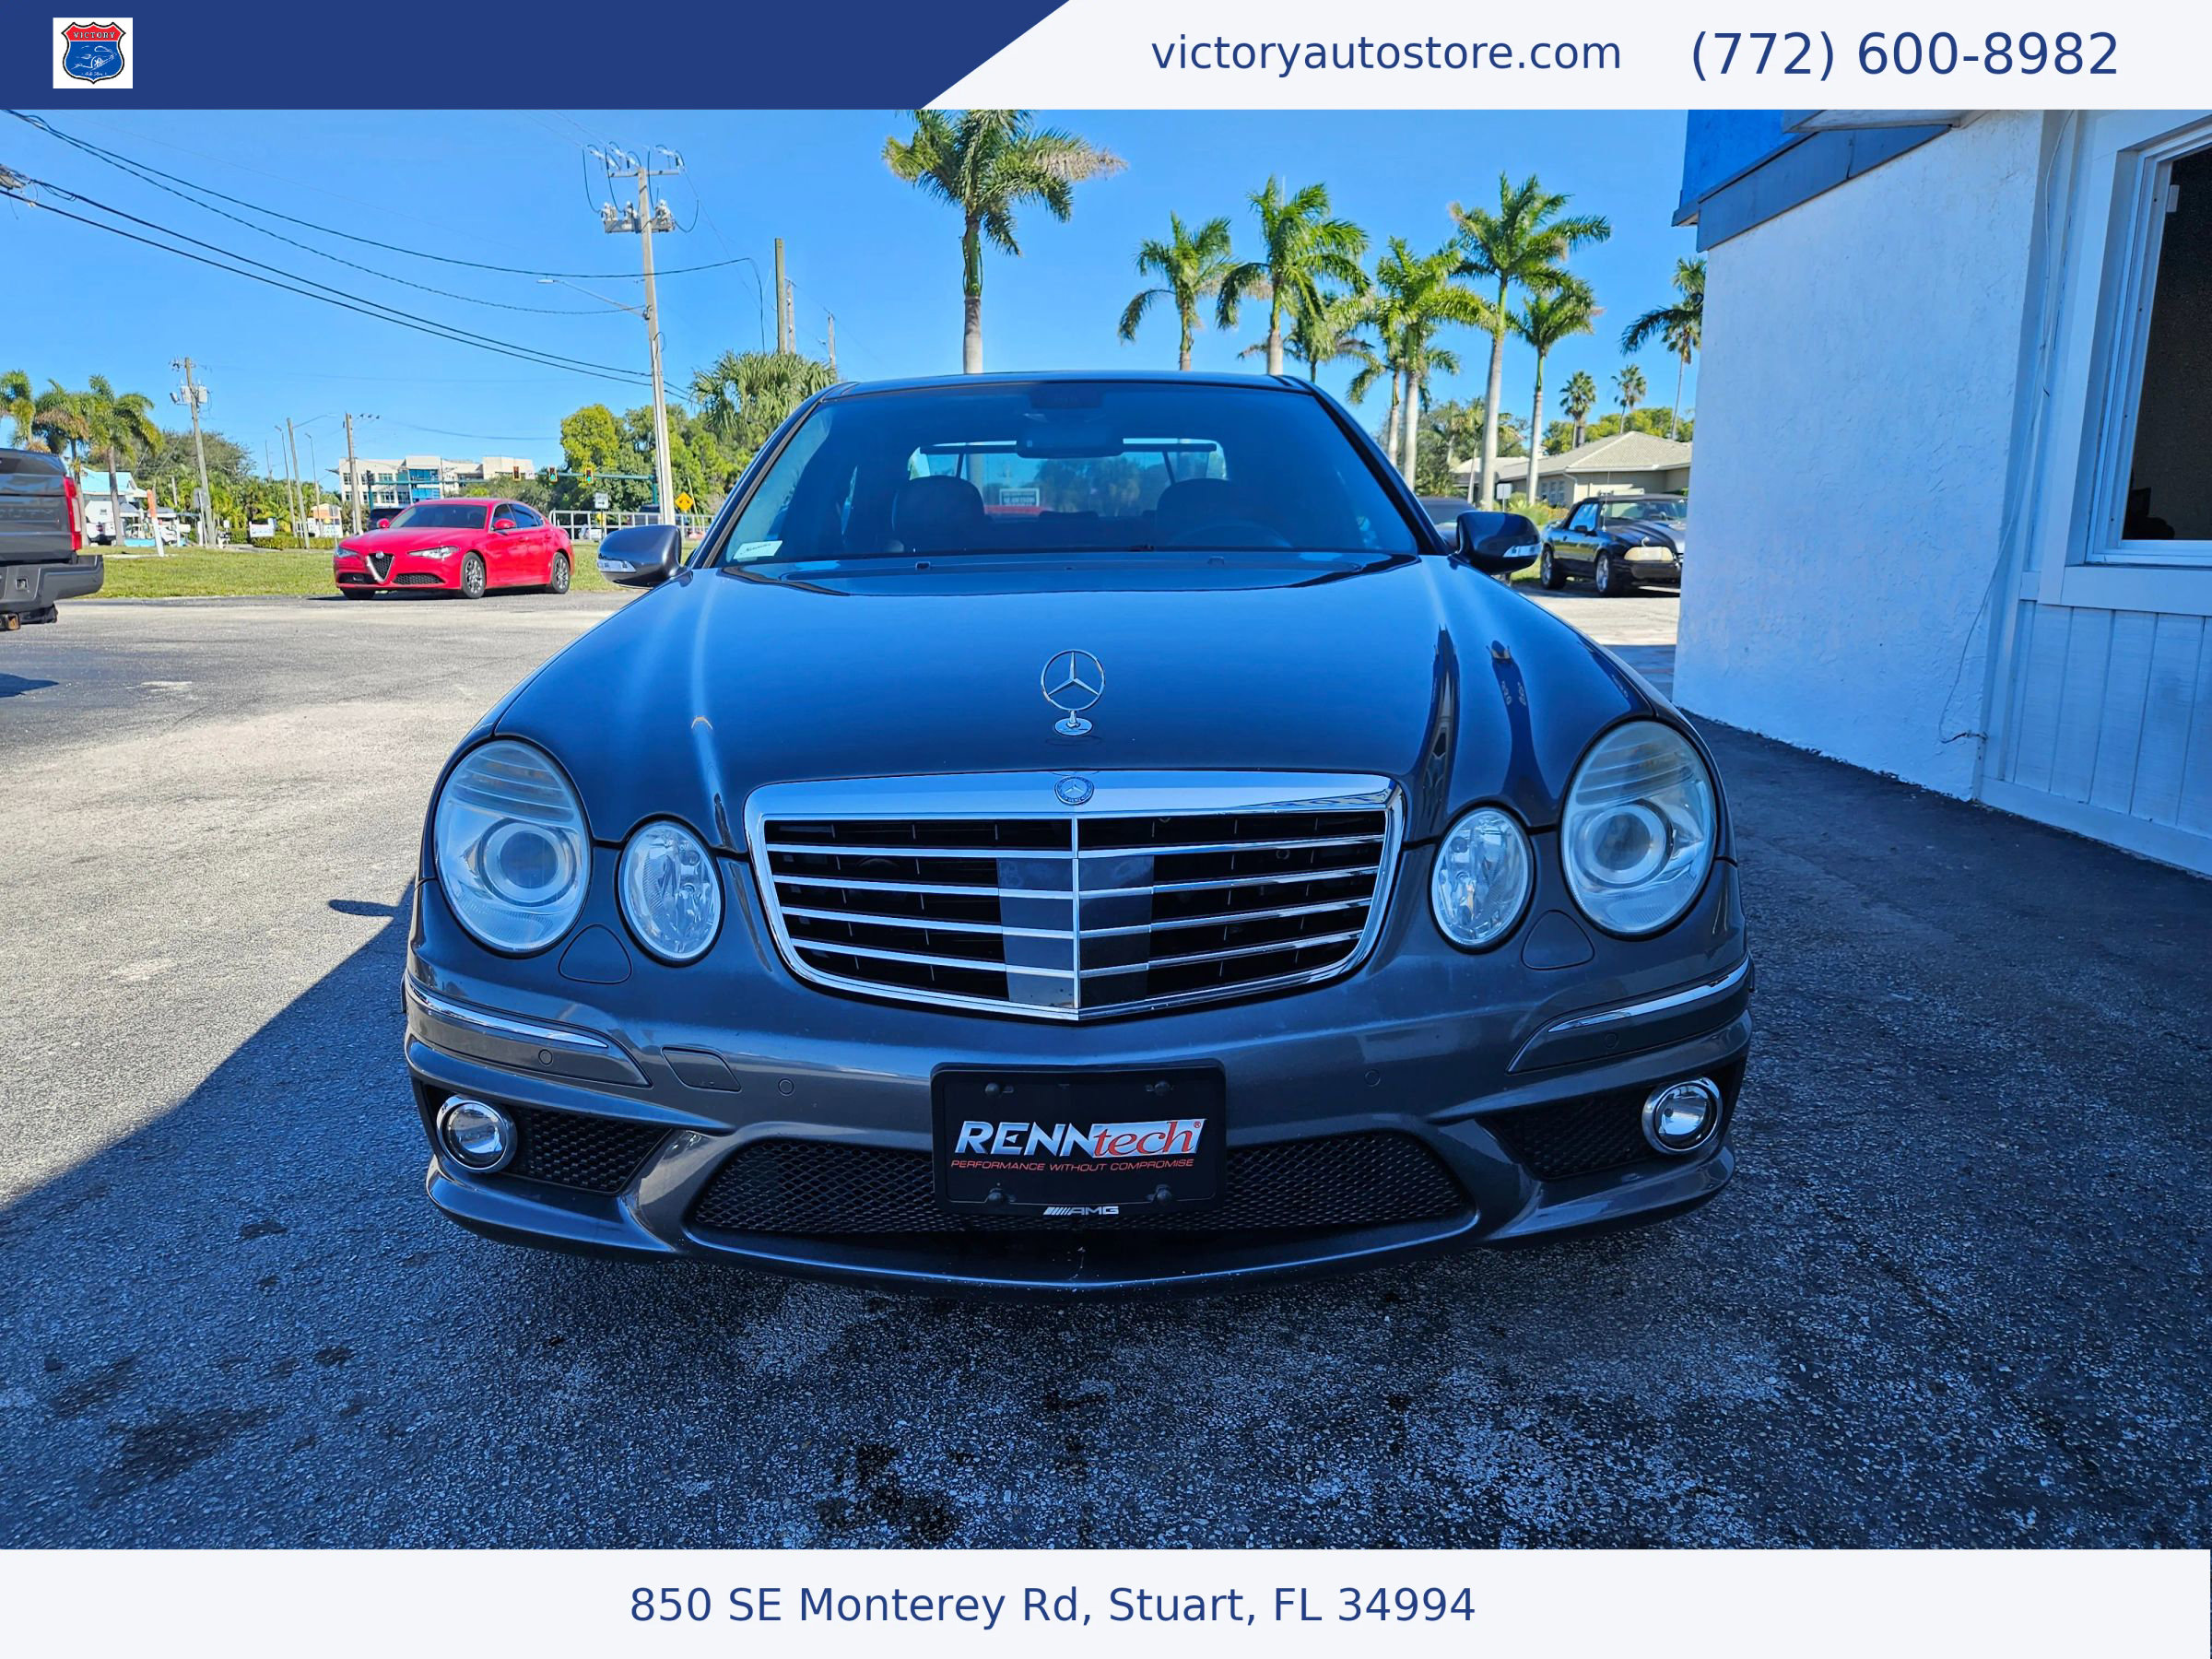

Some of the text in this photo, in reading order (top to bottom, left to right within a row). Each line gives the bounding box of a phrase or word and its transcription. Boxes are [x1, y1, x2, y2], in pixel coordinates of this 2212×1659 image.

[950, 1159, 1194, 1172] PERFORMANCE WITHOUT COMPROMISE
